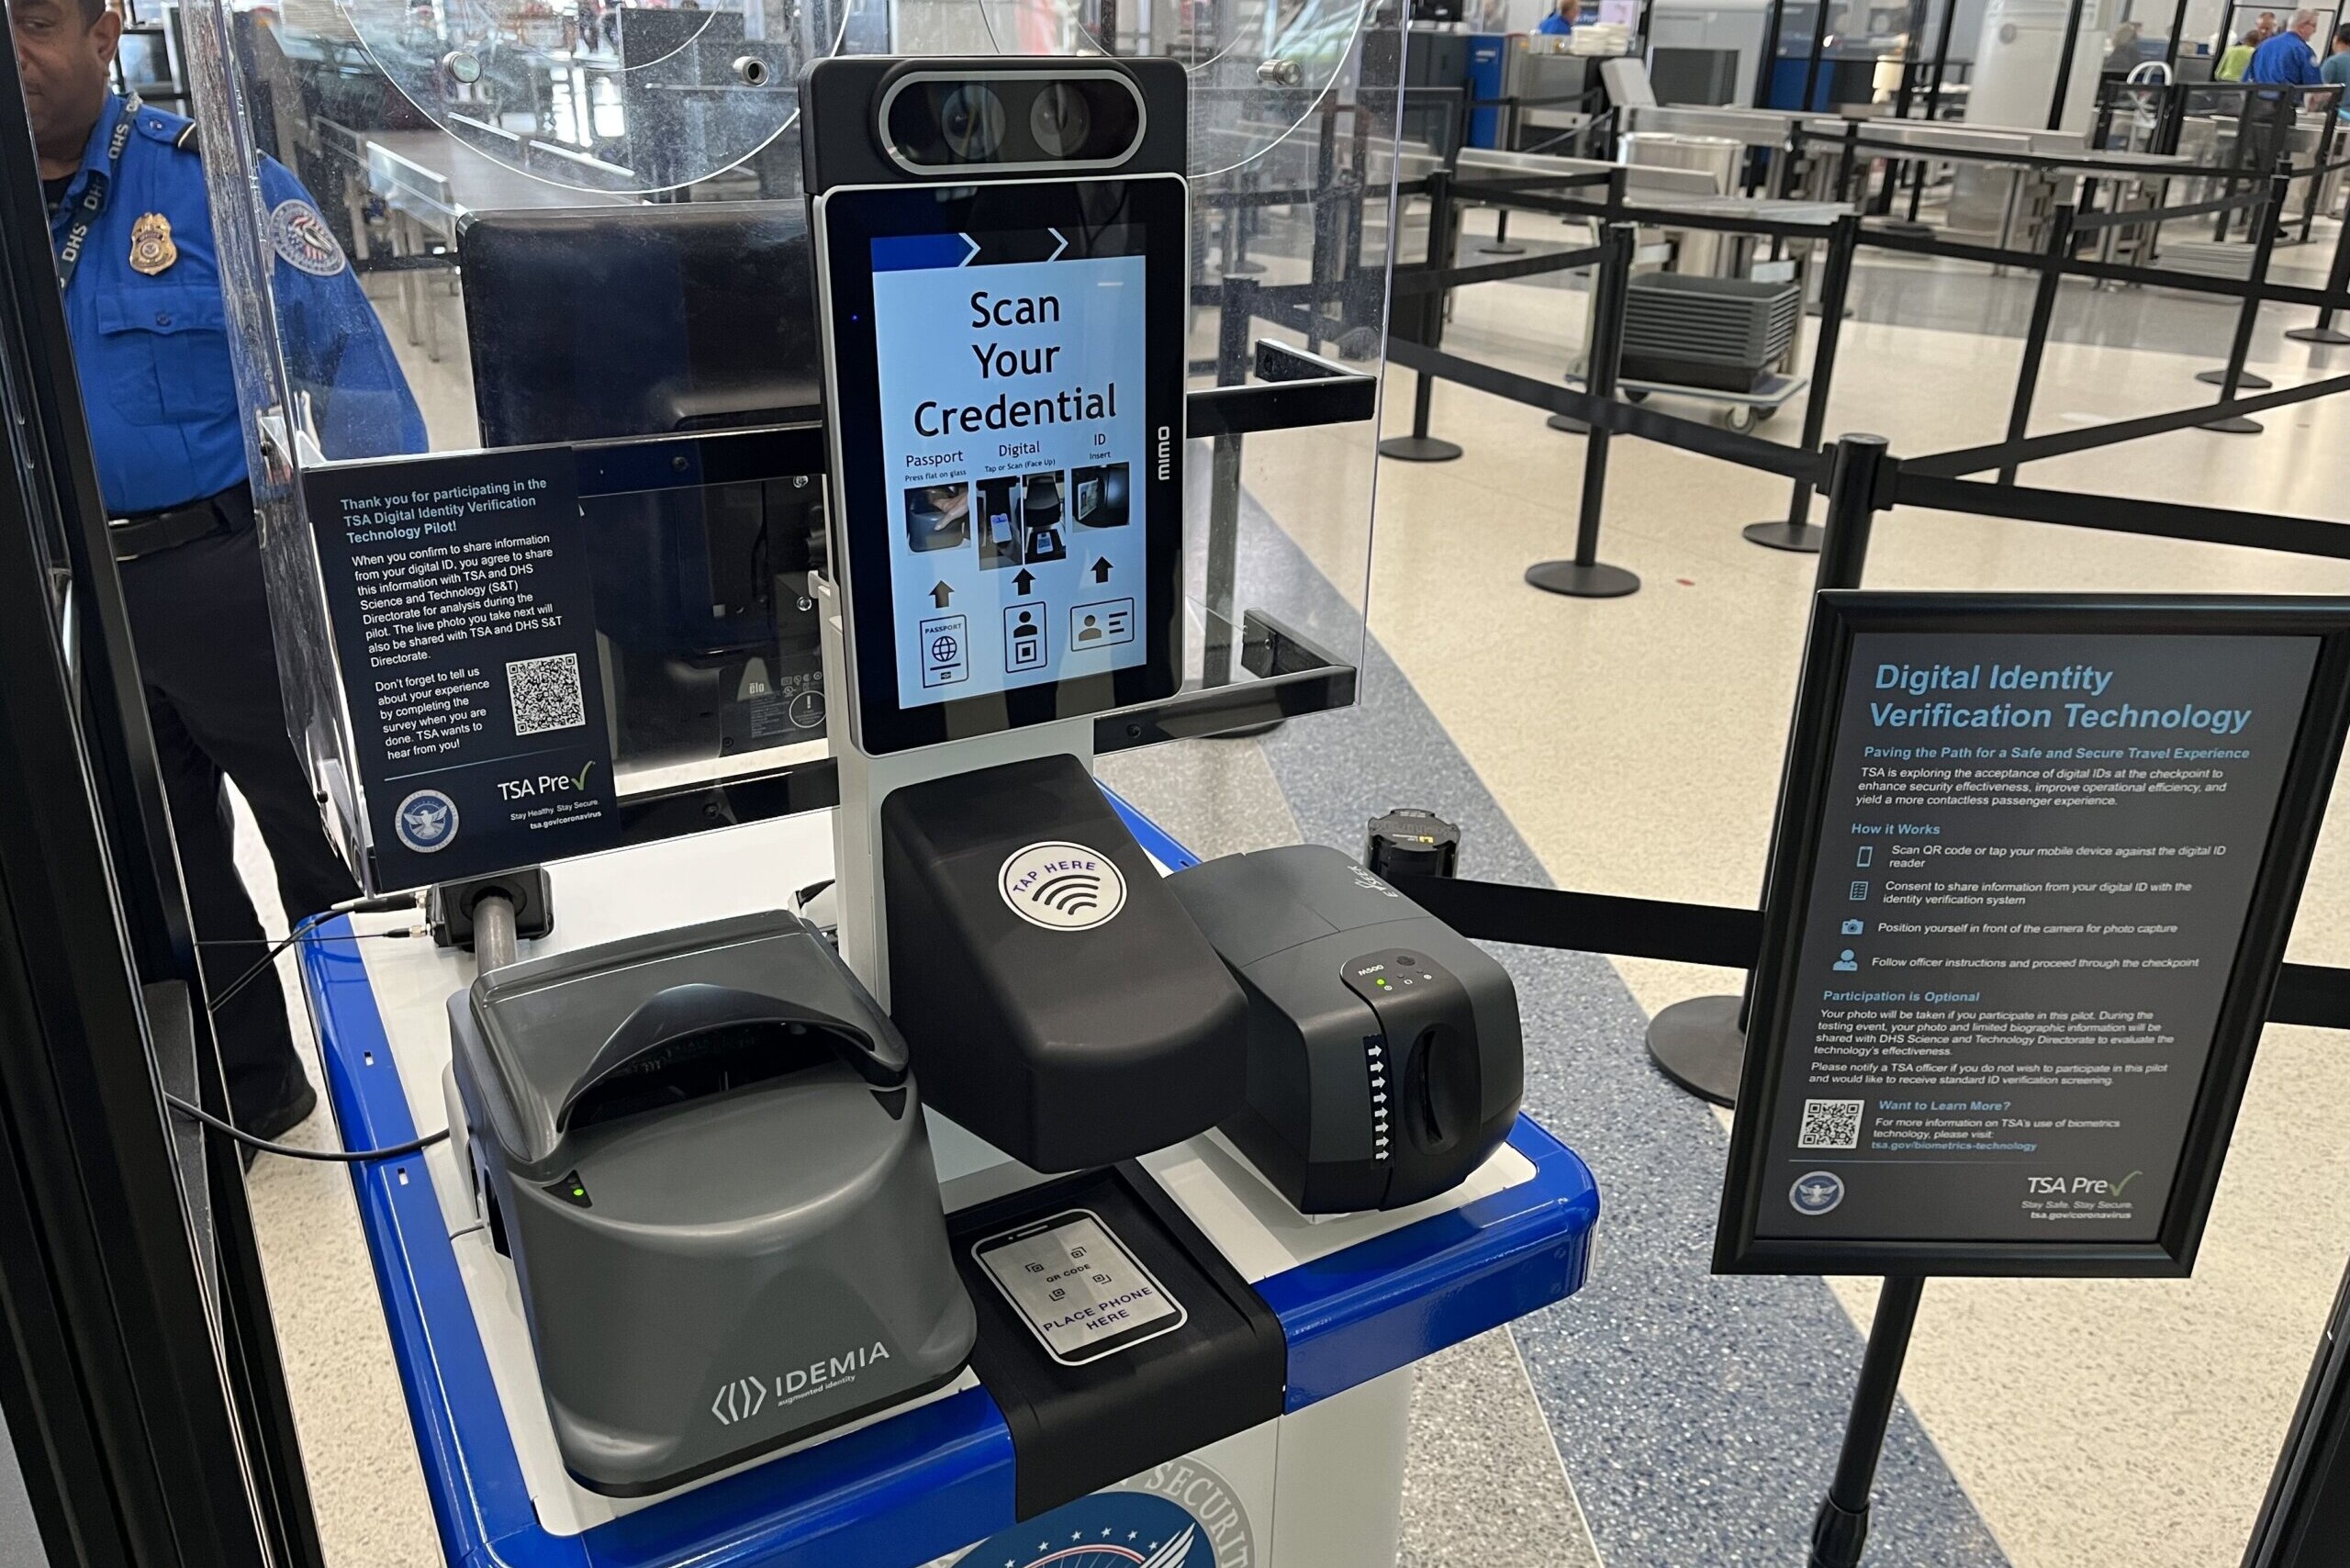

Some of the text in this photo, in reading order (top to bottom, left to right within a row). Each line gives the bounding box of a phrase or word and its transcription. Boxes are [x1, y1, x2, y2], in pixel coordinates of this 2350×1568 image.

[108, 123, 129, 159] DHS
[62, 225, 87, 263] DHS
[970, 291, 1059, 328] Scan
[971, 342, 1060, 378] Your
[914, 382, 1116, 437] Credential
[999, 441, 1040, 458] Digital
[1093, 433, 1106, 446] ID
[906, 450, 964, 468] Passport
[1089, 451, 1111, 460] Insert
[1158, 426, 1169, 480] mimo
[925, 472, 938, 480] flat
[951, 469, 967, 478] glass
[984, 465, 996, 474] Tap
[1025, 461, 1042, 469] (Face
[1043, 459, 1056, 468] Up)
[341, 478, 547, 510] Thank you for participating in the
[343, 497, 536, 527] TSA Digital Identity Verification
[346, 520, 457, 543] Technology Pilot!
[352, 535, 550, 566] When you confirm to share information
[354, 549, 553, 581] from your digital ID, you agree to share
[357, 564, 534, 596] this information with TSA and DHS
[360, 580, 519, 610] Science and Technology (S&T)
[363, 593, 533, 625] Directorate for analysis during the
[925, 623, 961, 633] PASSPORT
[371, 651, 431, 667] Directorate.
[405, 674, 436, 688] forget
[437, 673, 448, 682] to
[450, 668, 465, 680] tell
[467, 668, 480, 678] us
[1875, 665, 2113, 696] Digital Identity
[378, 680, 490, 706] about your experience
[1871, 702, 2252, 734] Verification Technology
[1864, 746, 2250, 761] Paving the Path for a Safe and Secure Travel Experience
[1862, 767, 2223, 780] TSA is exploring the acceptance of digital IDs at the checkpoint to
[498, 778, 535, 801] TSA
[1852, 823, 1941, 834] How it Works
[1892, 845, 2226, 857] Scan QR code or tap your mobile device against the digital ID
[1889, 858, 1926, 868] reader
[1013, 860, 1096, 893] TAP HERE
[1883, 894, 2026, 906] identity verification system
[1358, 964, 1384, 976] M500
[1823, 991, 1980, 1004] Participation is Optional
[1882, 1047, 1954, 1056] effectiveness.
[1879, 1101, 2011, 1111] Want to Learn More?
[2028, 1177, 2066, 1193] TSA
[1046, 1263, 1092, 1283] QR CODE
[1043, 1286, 1153, 1332] PLACE PHONE
[1086, 1309, 1130, 1330] HERE
[776, 1341, 890, 1397] IDEMIA
[778, 1374, 856, 1407] augmented identity
